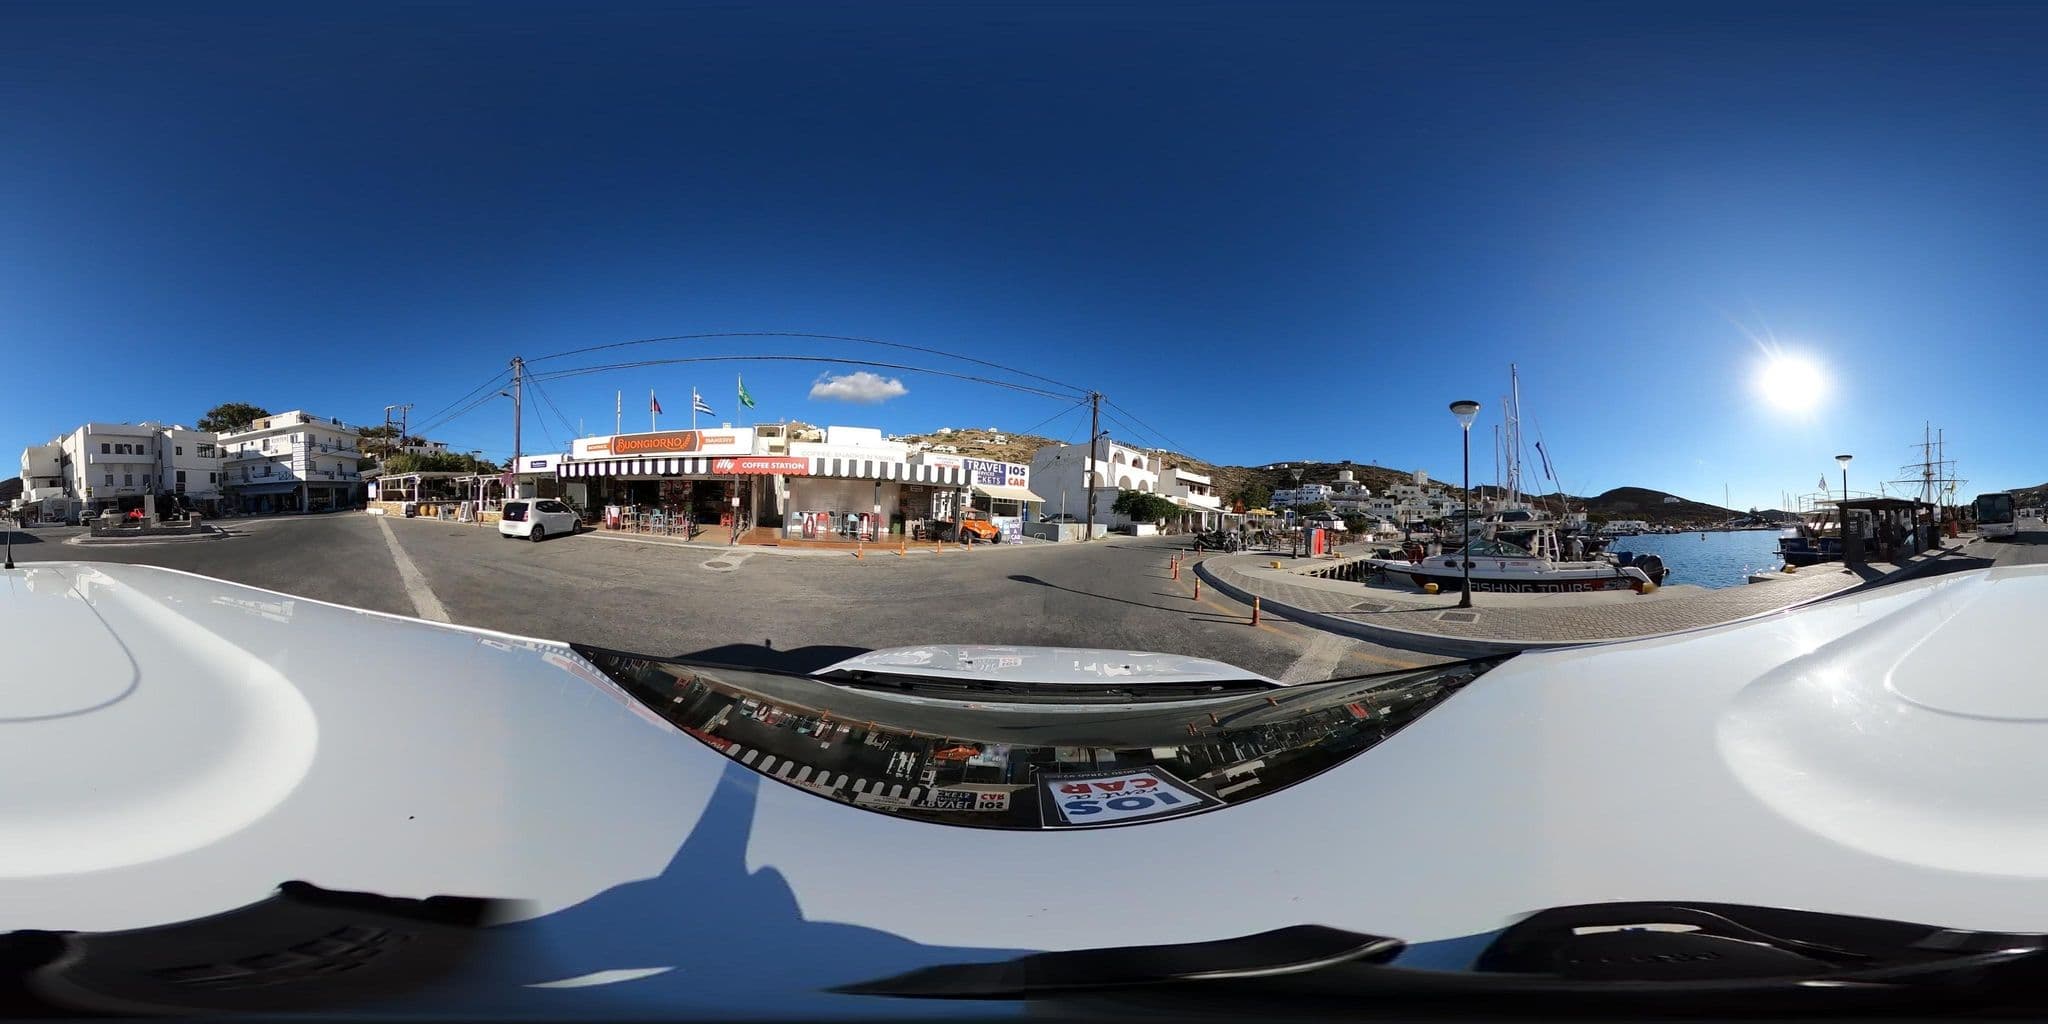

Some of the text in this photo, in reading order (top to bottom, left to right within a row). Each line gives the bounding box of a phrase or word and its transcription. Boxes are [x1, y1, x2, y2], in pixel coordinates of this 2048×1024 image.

[717, 459, 734, 470] illy
[967, 460, 1004, 473] TRAVEL
[1009, 466, 1026, 476] IOS
[1008, 477, 1025, 487] CAR
[1471, 582, 1532, 592] FISHING
[1537, 582, 1594, 592] TOURS
[1060, 778, 1159, 794] CAR
[1097, 787, 1159, 799] rent
[1064, 792, 1181, 816] IOS
